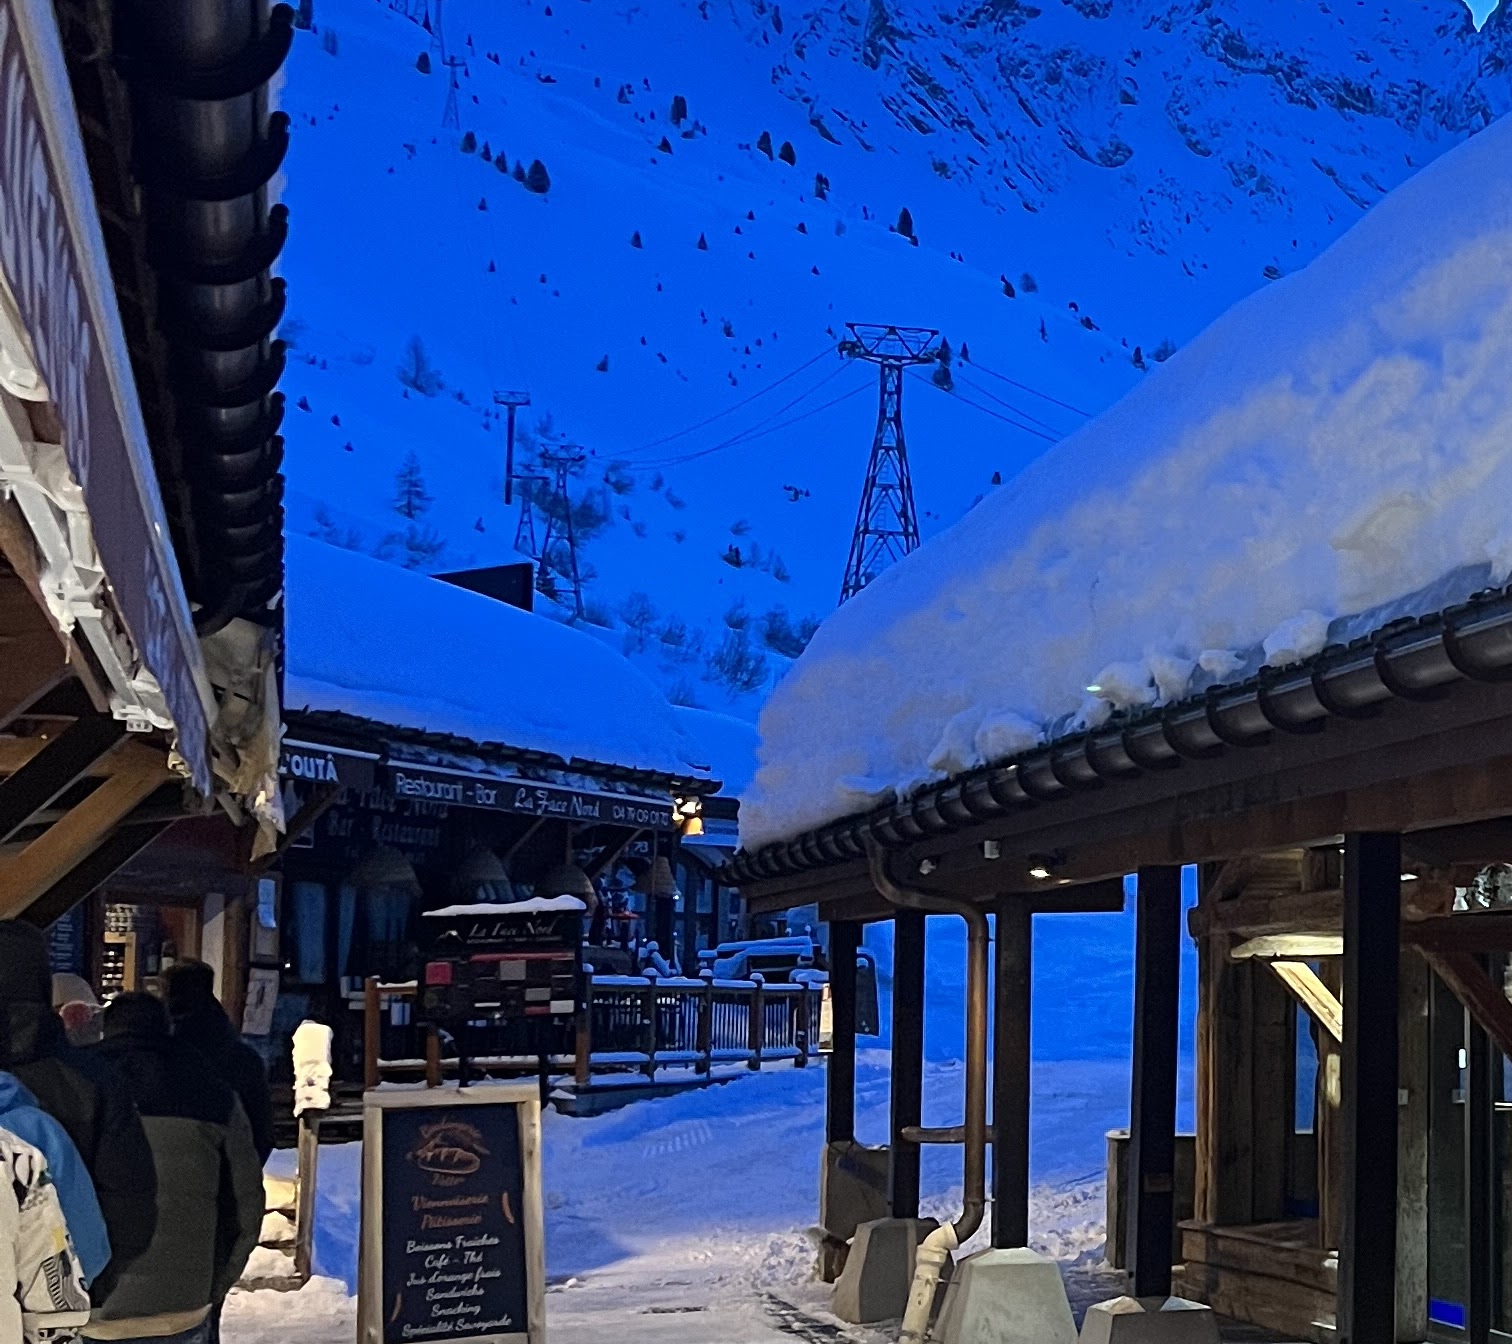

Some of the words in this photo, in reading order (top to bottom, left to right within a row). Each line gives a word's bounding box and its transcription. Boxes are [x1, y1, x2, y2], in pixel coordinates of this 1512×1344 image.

[395, 772, 463, 803] Restaurant
[475, 783, 498, 805] Bar
[514, 787, 534, 809] La
[535, 789, 568, 815] Face
[569, 795, 601, 818] Nord
